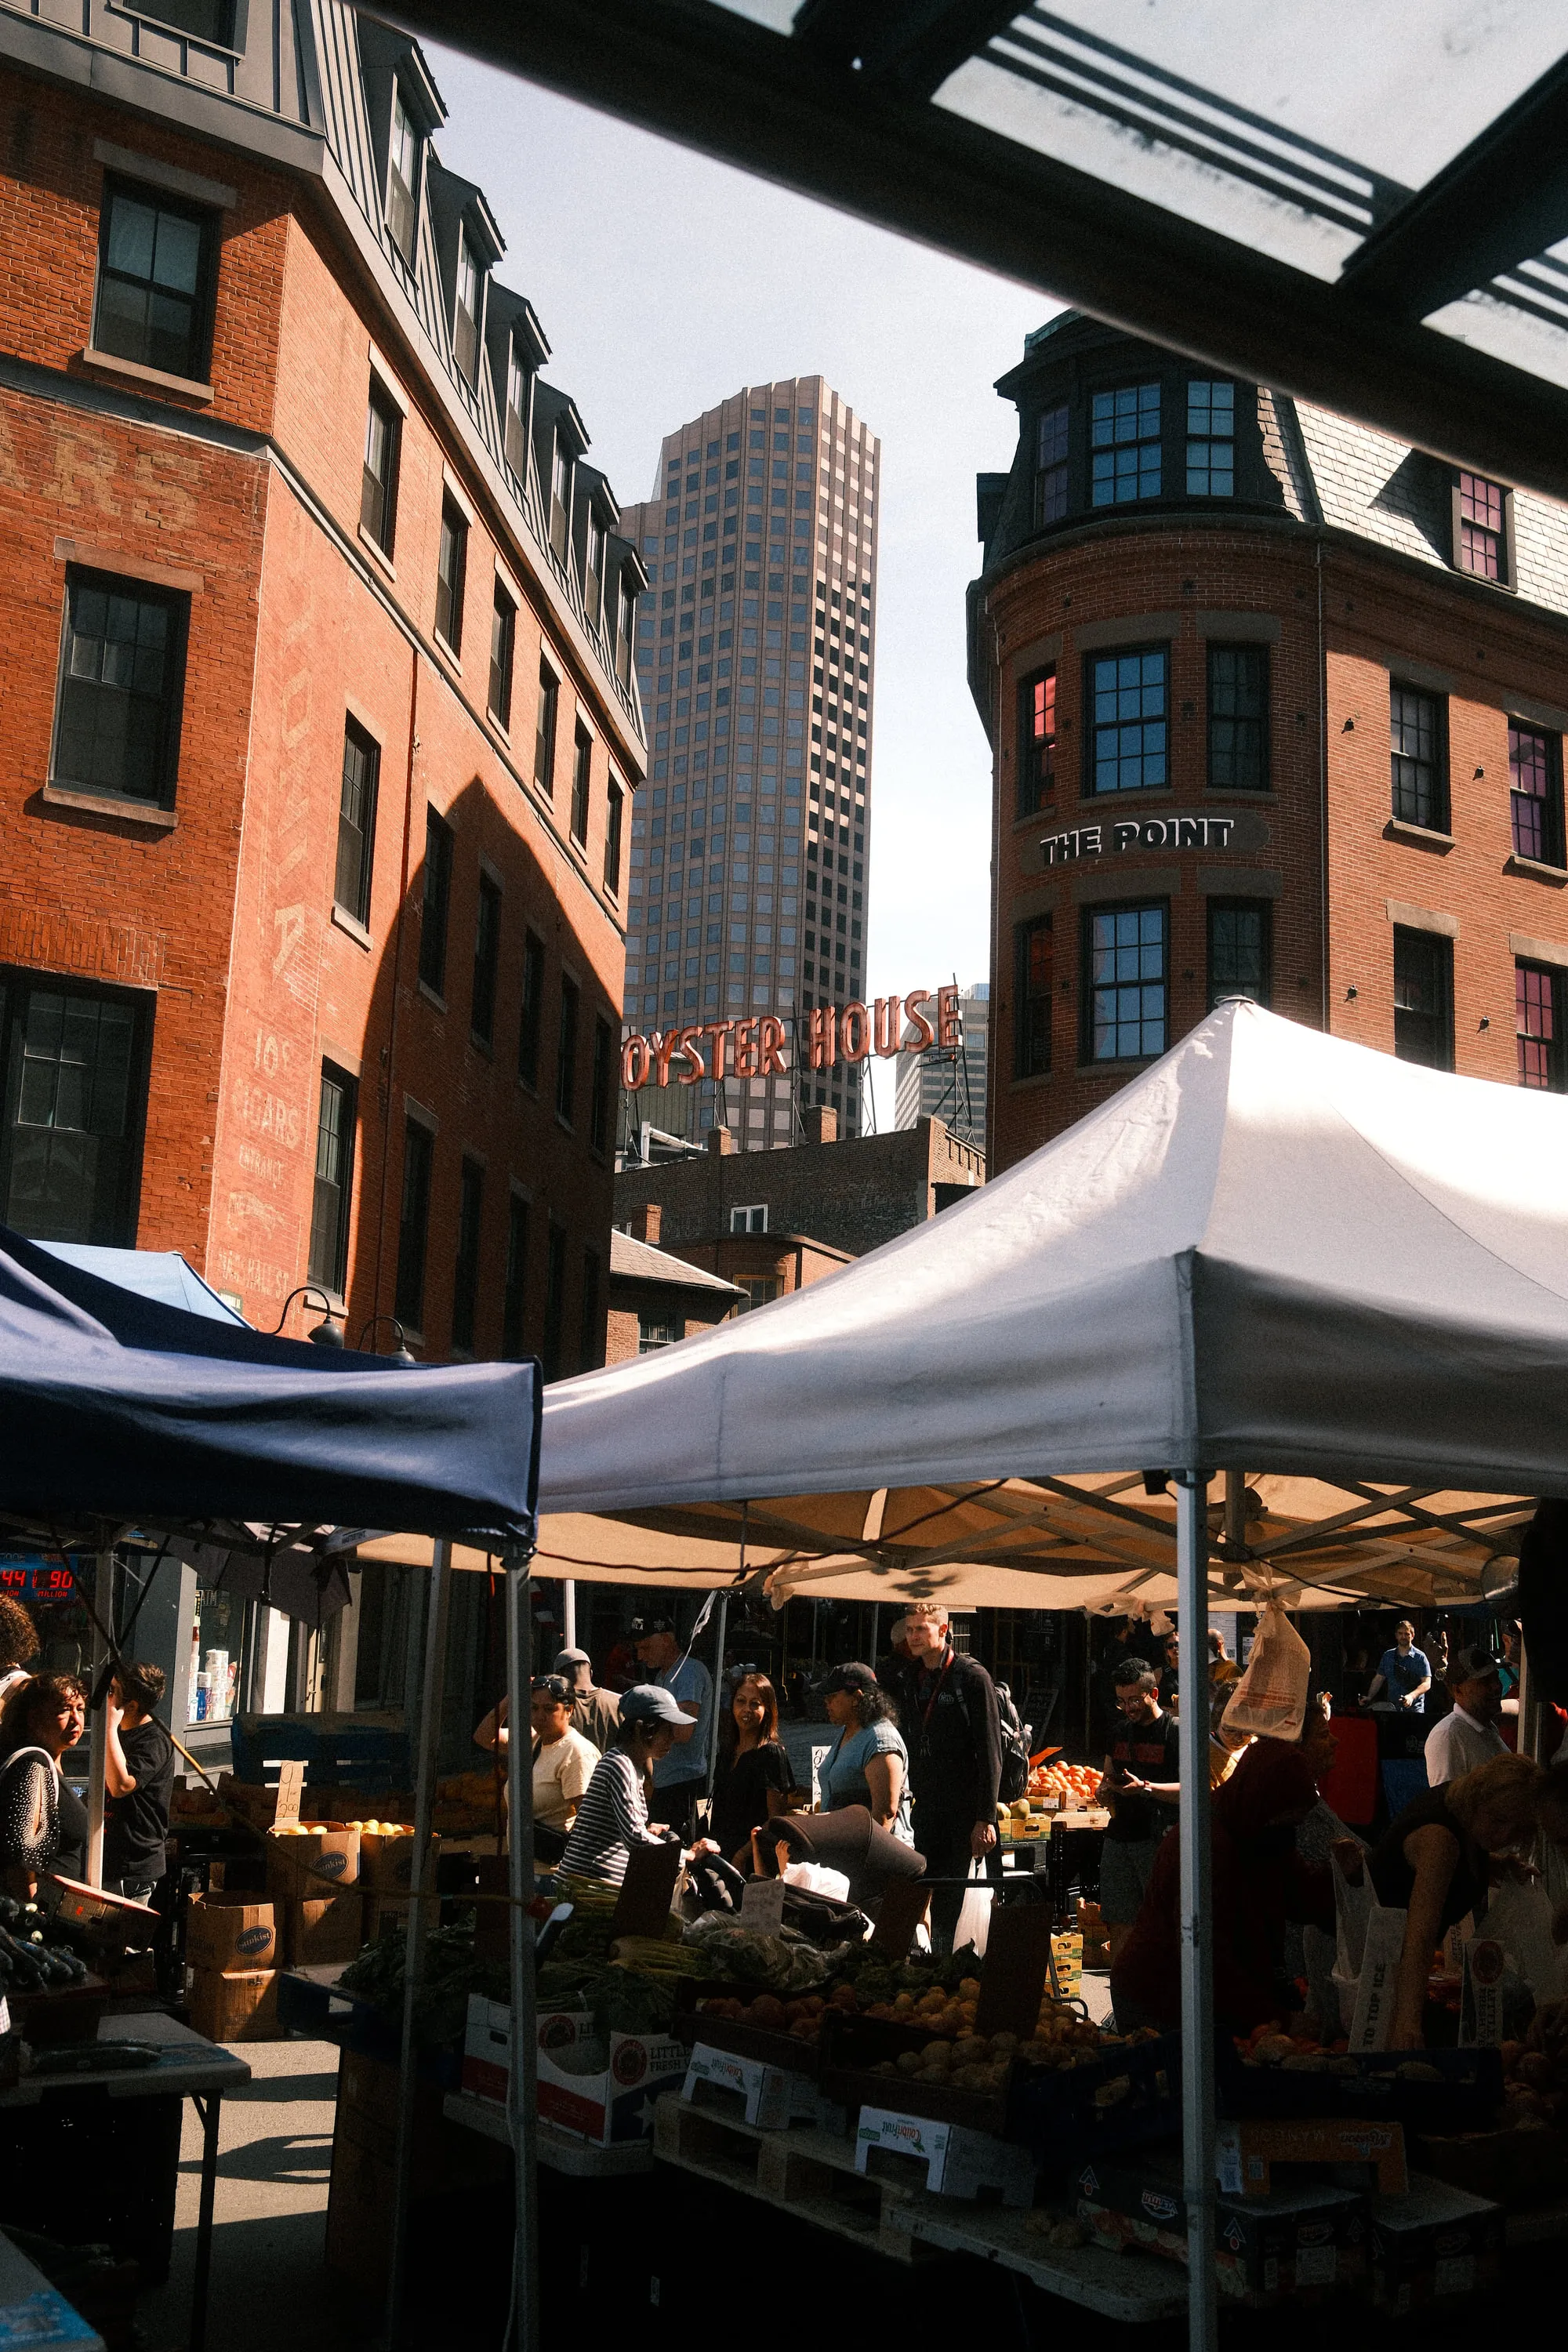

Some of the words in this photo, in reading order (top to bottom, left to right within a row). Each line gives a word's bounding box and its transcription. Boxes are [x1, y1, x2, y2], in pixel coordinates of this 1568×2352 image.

[1040, 826, 1102, 866] THE
[1113, 818, 1235, 851] POINT
[621, 1015, 787, 1091] OYSTER
[809, 984, 963, 1069] HOUSE
[230, 1078, 299, 1149] CIGARS
[37, 1589, 69, 1598] MILLION
[1373, 1962, 1386, 1989] ICE
[1367, 1998, 1380, 2023] TOP
[1486, 1987, 1496, 2042] LITTLE
[650, 2060, 681, 2072] FRESH
